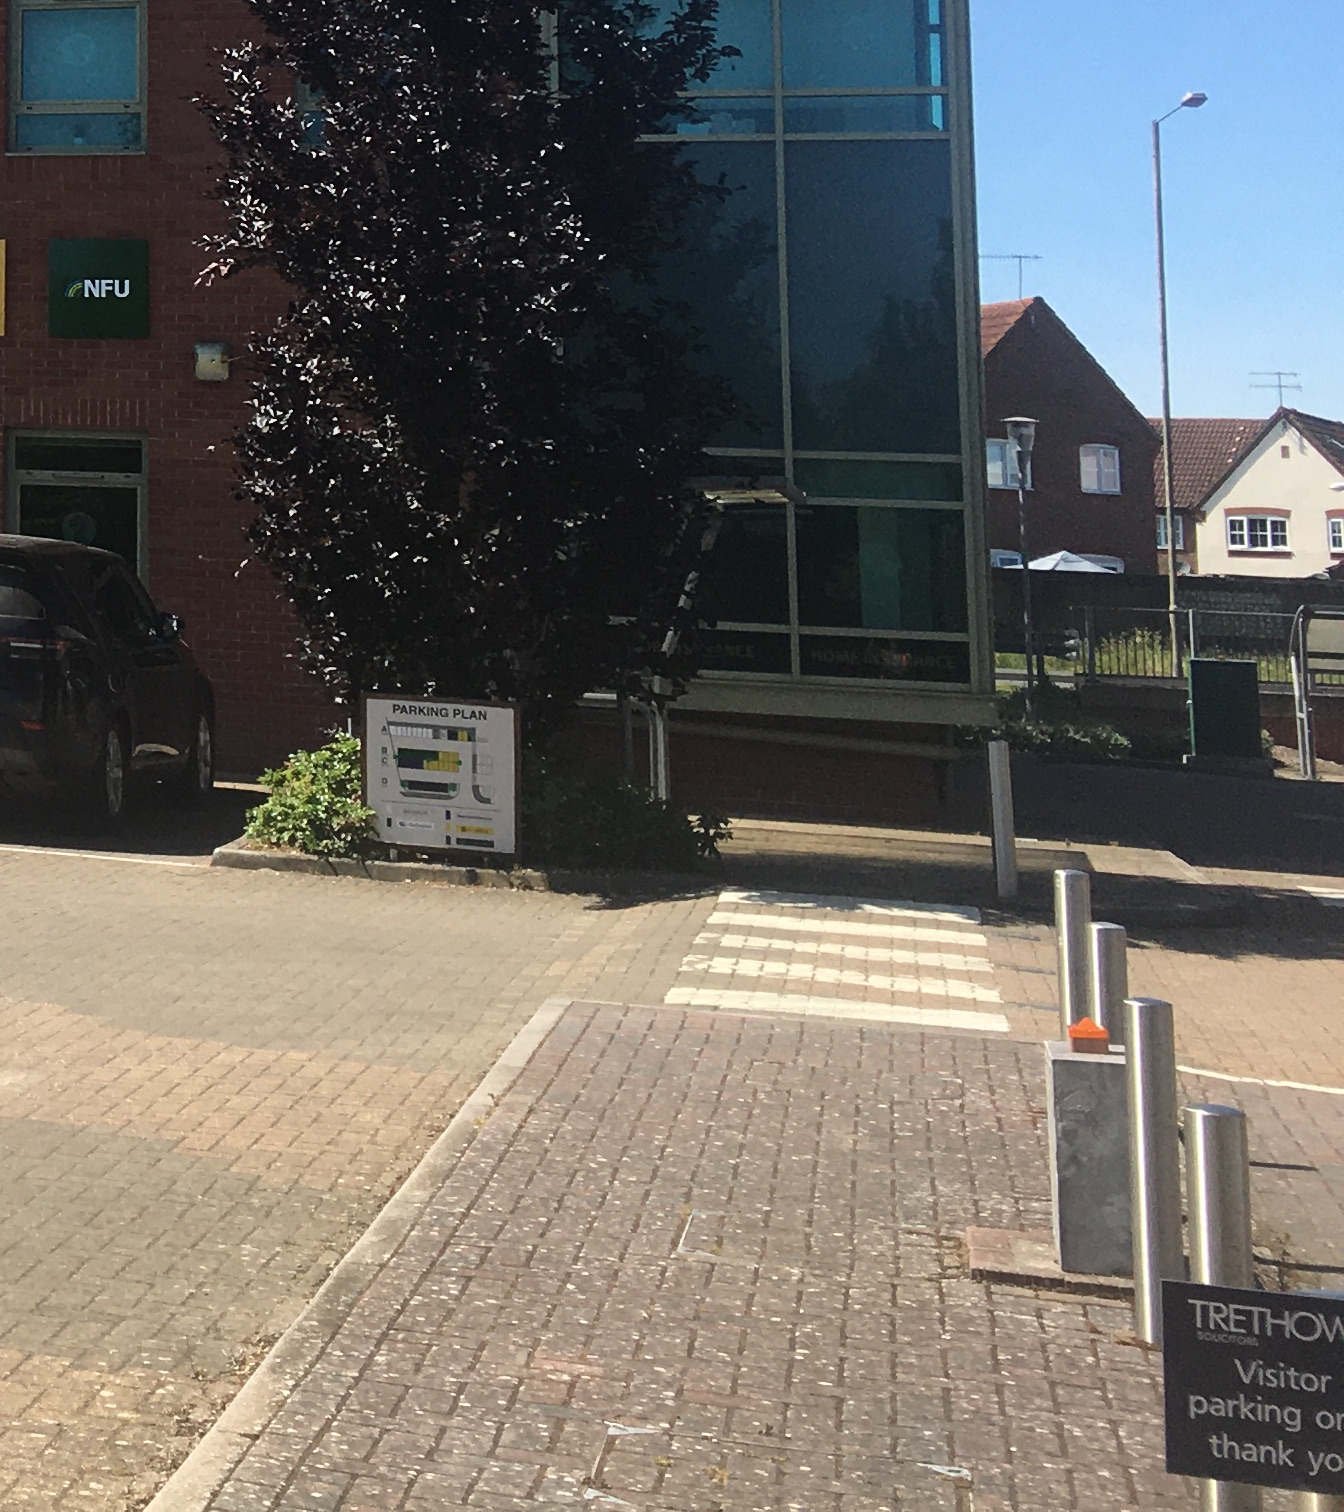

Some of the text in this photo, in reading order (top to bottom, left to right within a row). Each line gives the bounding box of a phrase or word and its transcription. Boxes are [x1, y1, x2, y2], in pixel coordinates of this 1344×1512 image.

[84, 279, 130, 298] NFU
[392, 703, 488, 721] PARKING PLAN
[1187, 1298, 1344, 1343] TRETHOW
[1196, 1331, 1260, 1347] SOLICITORS
[1233, 1357, 1333, 1393] Visitor
[1188, 1390, 1302, 1433] parking
[1208, 1430, 1295, 1468] thank
